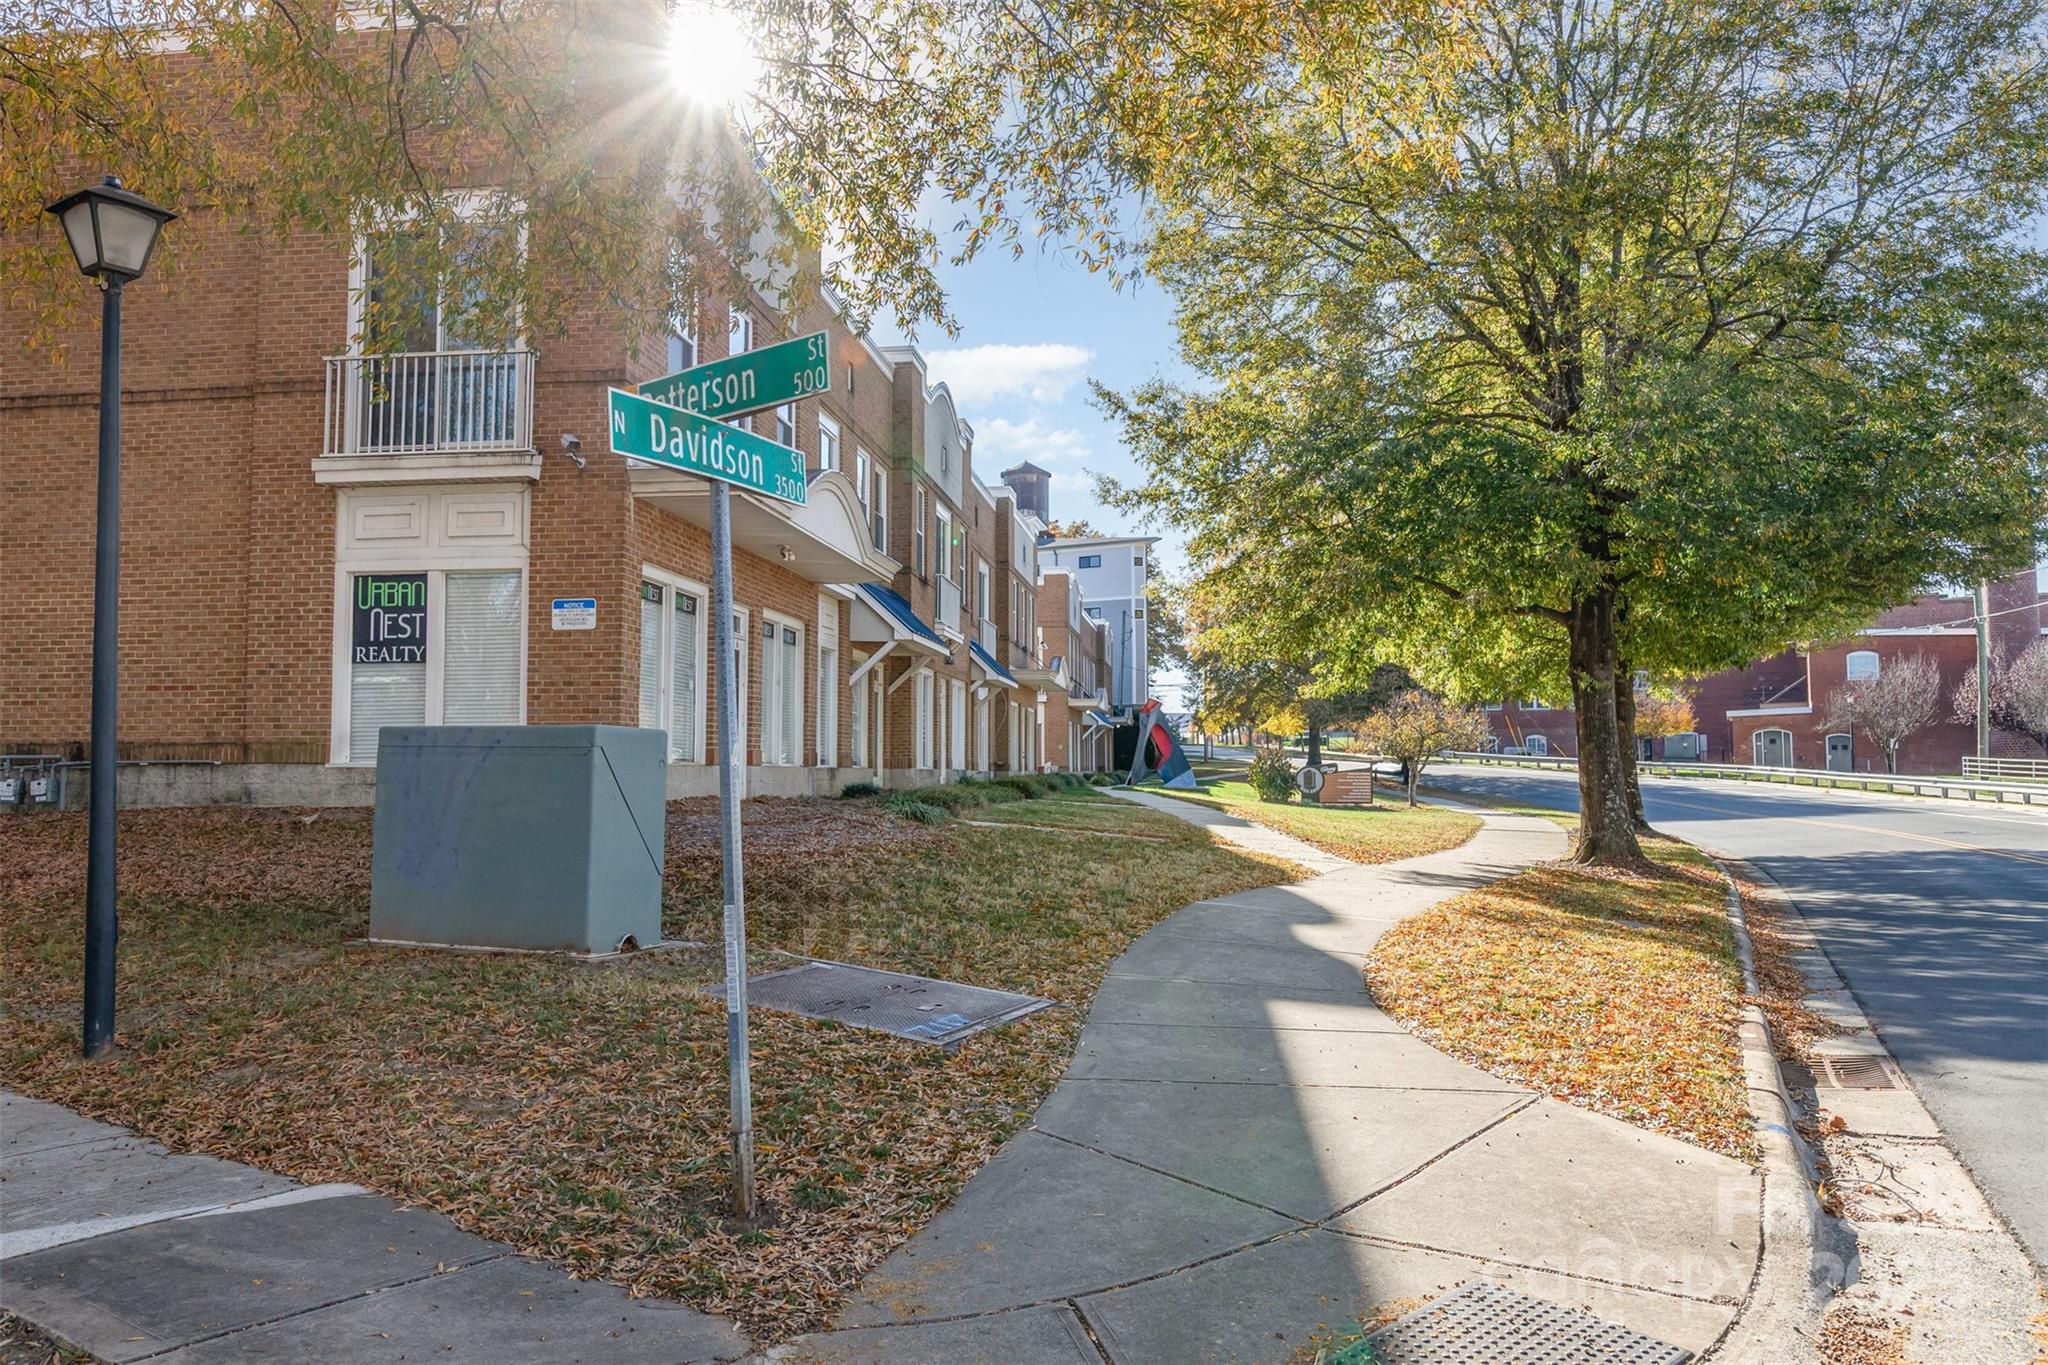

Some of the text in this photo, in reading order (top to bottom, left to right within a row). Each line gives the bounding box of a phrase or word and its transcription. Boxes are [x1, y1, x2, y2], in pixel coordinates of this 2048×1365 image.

[807, 335, 824, 361] St
[793, 366, 826, 395] 500
[614, 409, 803, 486] N Davidson St
[774, 474, 804, 502] 3500
[358, 576, 425, 609] URBAN
[370, 608, 425, 641] NEST
[355, 645, 425, 662] REALTY
